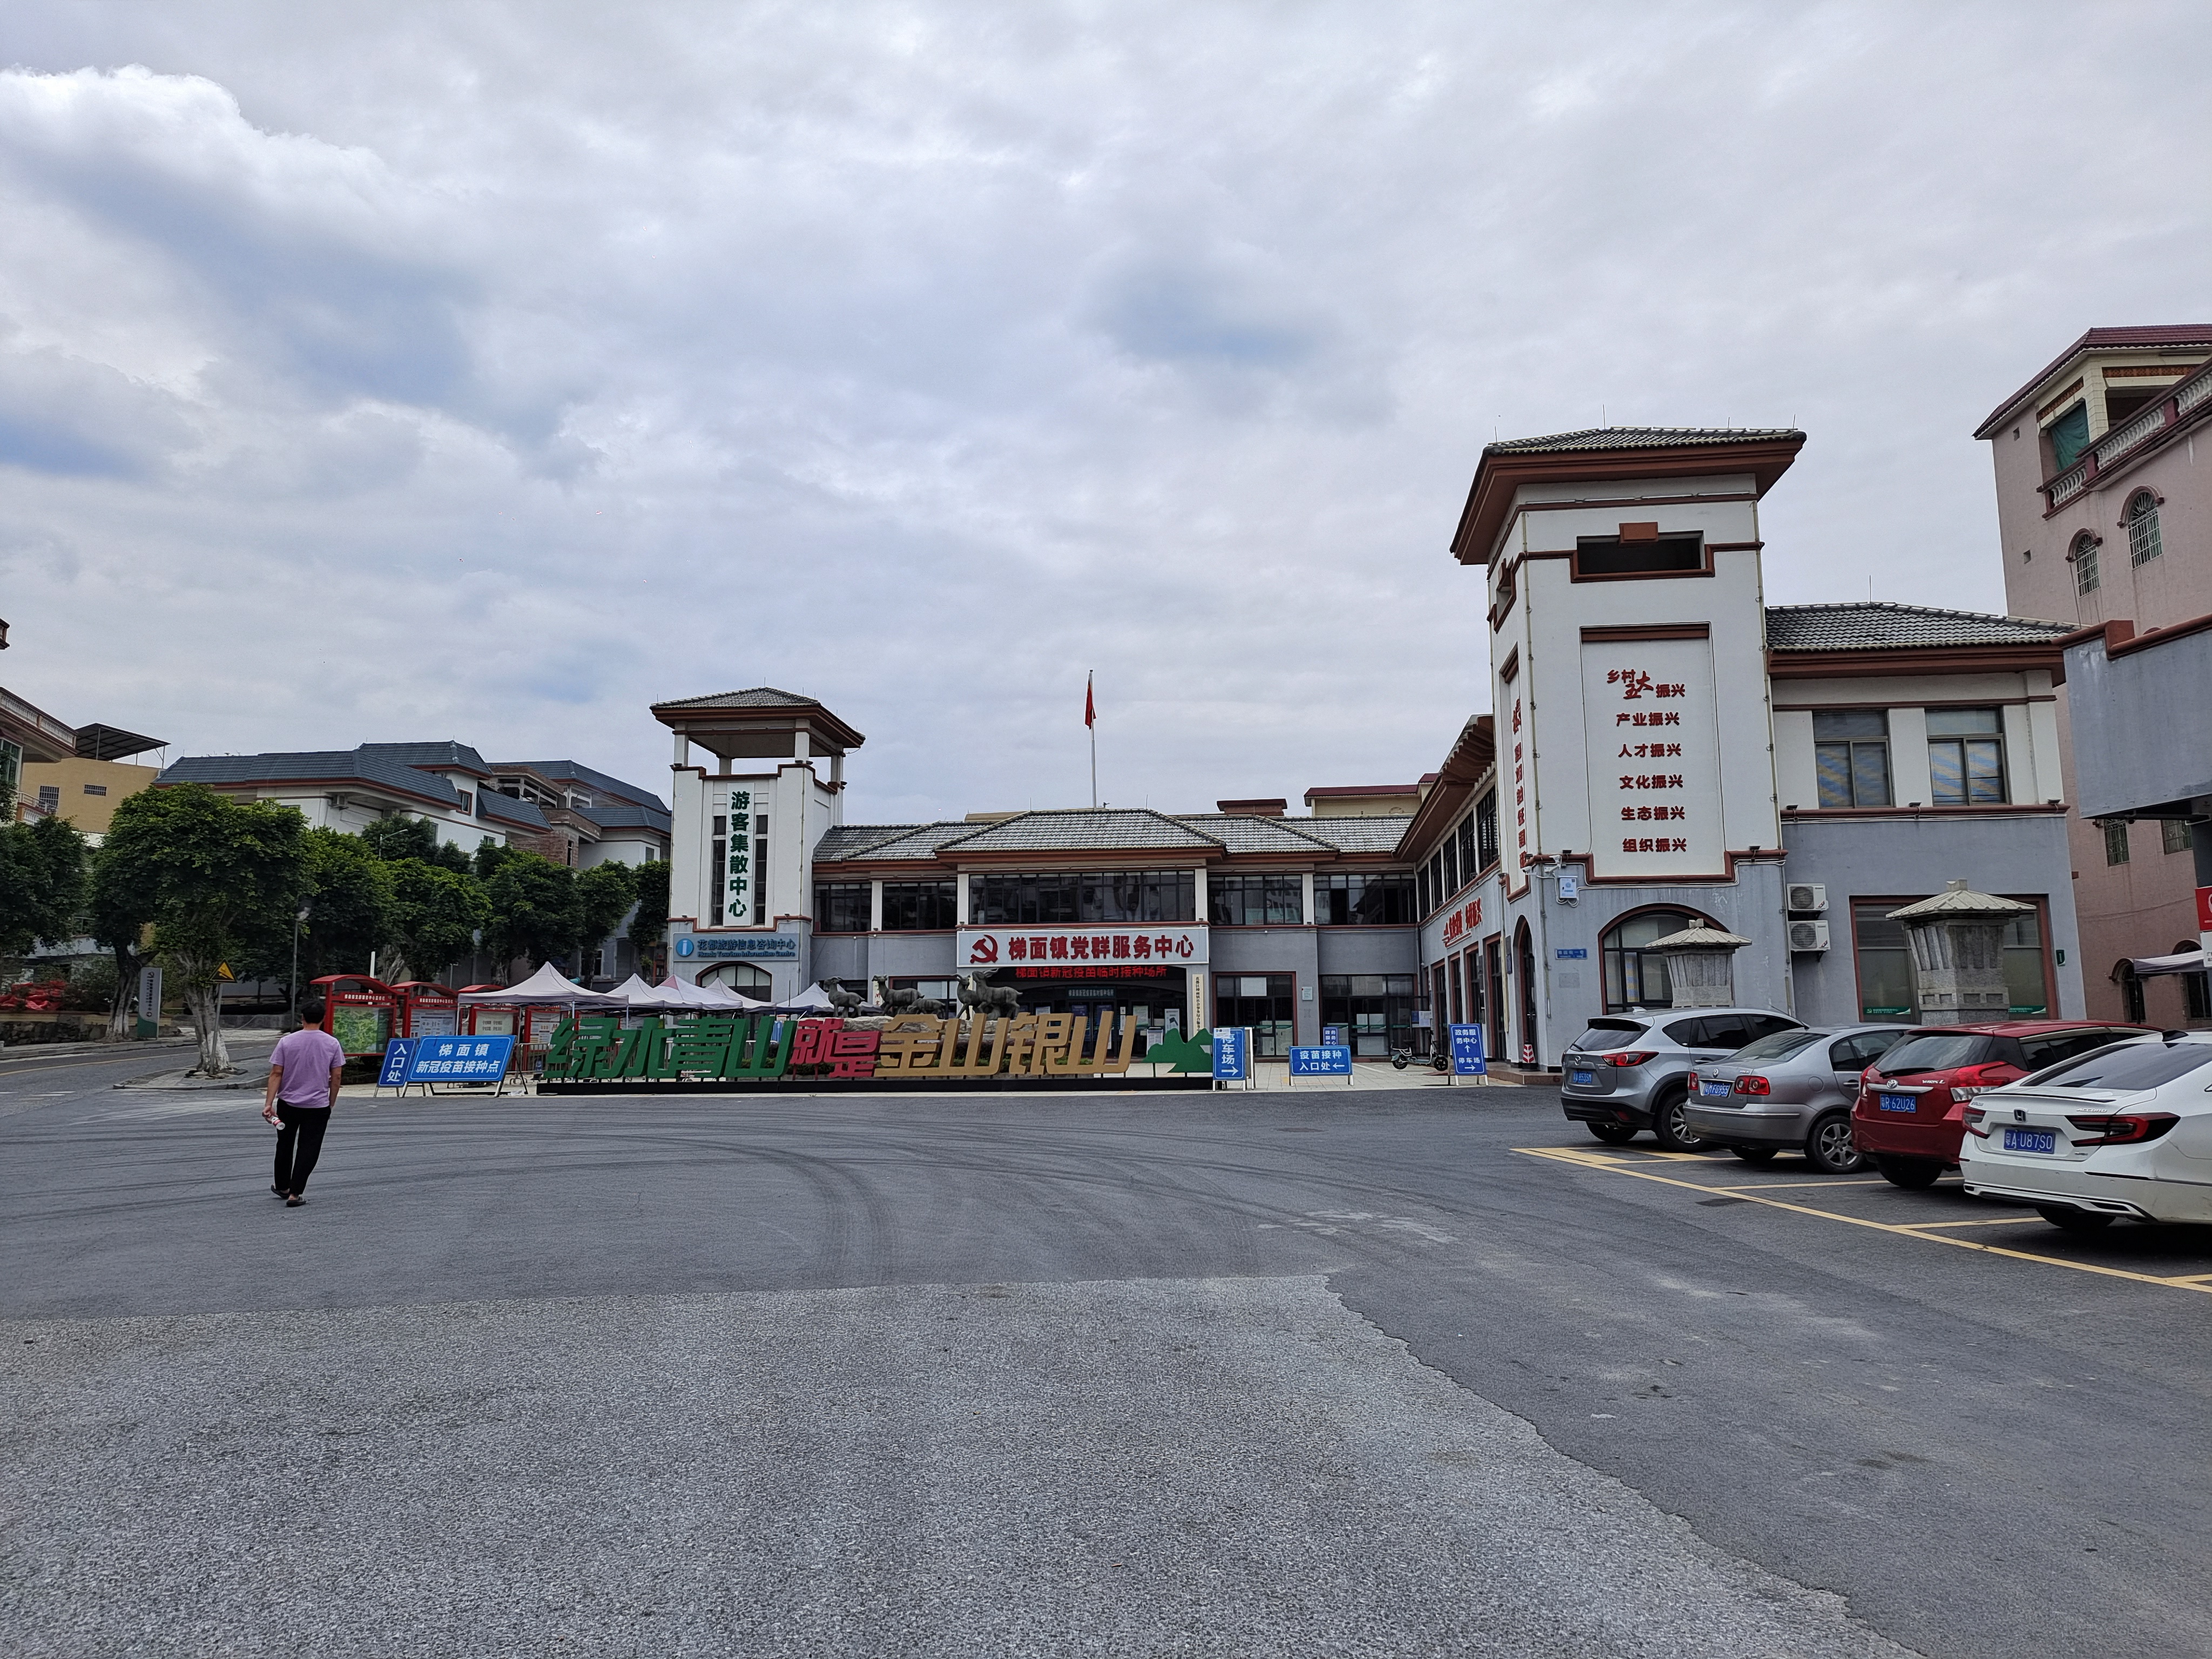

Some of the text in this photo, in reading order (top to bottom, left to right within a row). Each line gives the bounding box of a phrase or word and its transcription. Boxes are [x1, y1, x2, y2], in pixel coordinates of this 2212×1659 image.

[1616, 712, 1680, 727] 产业振兴
[1618, 743, 1682, 758] 人才振兴
[1619, 774, 1683, 790] 文化振兴
[1621, 806, 1685, 820] 生态振兴
[1622, 838, 1687, 852] 组织振兴
[729, 791, 750, 918] 游客集散中心
[697, 938, 796, 951] 花都旅游信息咨询中心
[1008, 934, 1194, 961] 梯面镇党群服务中心
[438, 1043, 490, 1057] 梯面镇
[542, 1011, 1138, 1078] 绿水青山就是金山银山
[1299, 1050, 1342, 1060] 疫苗接种
[386, 1043, 407, 1082] 入口处
[415, 1060, 501, 1074] 新冠疫苗接种点
[1299, 1062, 1331, 1071] 入口处
